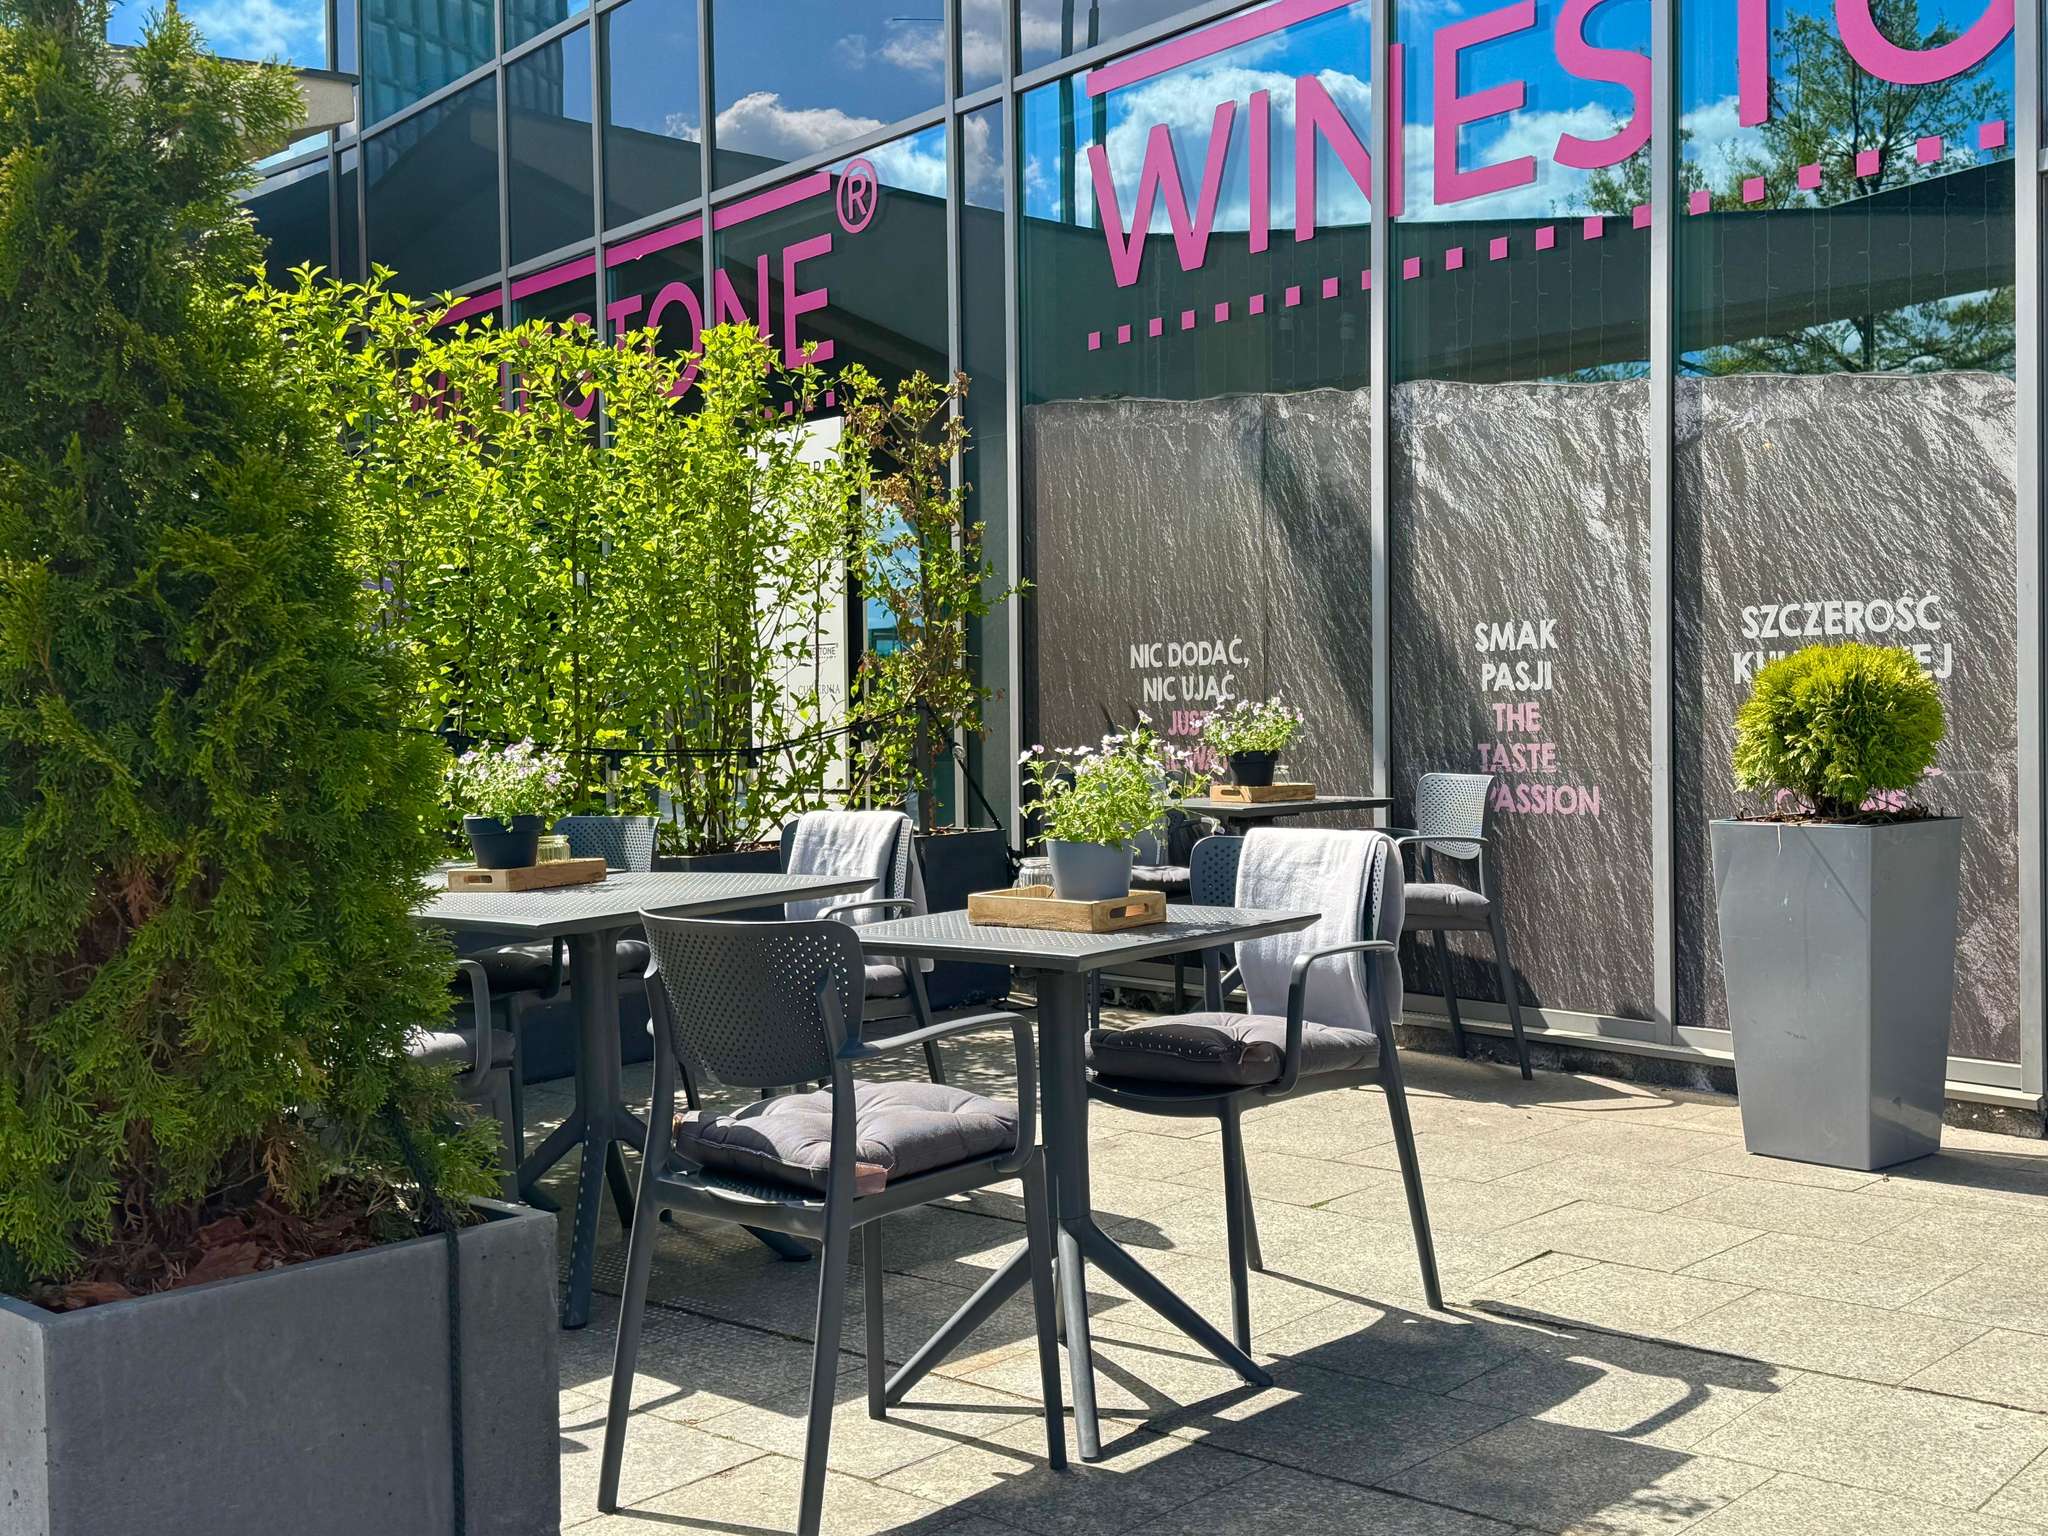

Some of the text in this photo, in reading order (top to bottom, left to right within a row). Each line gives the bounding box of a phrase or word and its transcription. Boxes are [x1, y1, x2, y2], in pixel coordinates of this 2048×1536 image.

[1741, 589, 1942, 639] SZCZEROŚĆ
[1130, 633, 1250, 669] NIC DODAĆ,
[1474, 619, 1559, 652] SMAK
[1143, 675, 1177, 702] NIC
[1481, 660, 1552, 692] PASJI
[1491, 702, 1543, 732] THE
[1477, 743, 1559, 774] TASTE
[1489, 783, 1601, 817] ASSION
